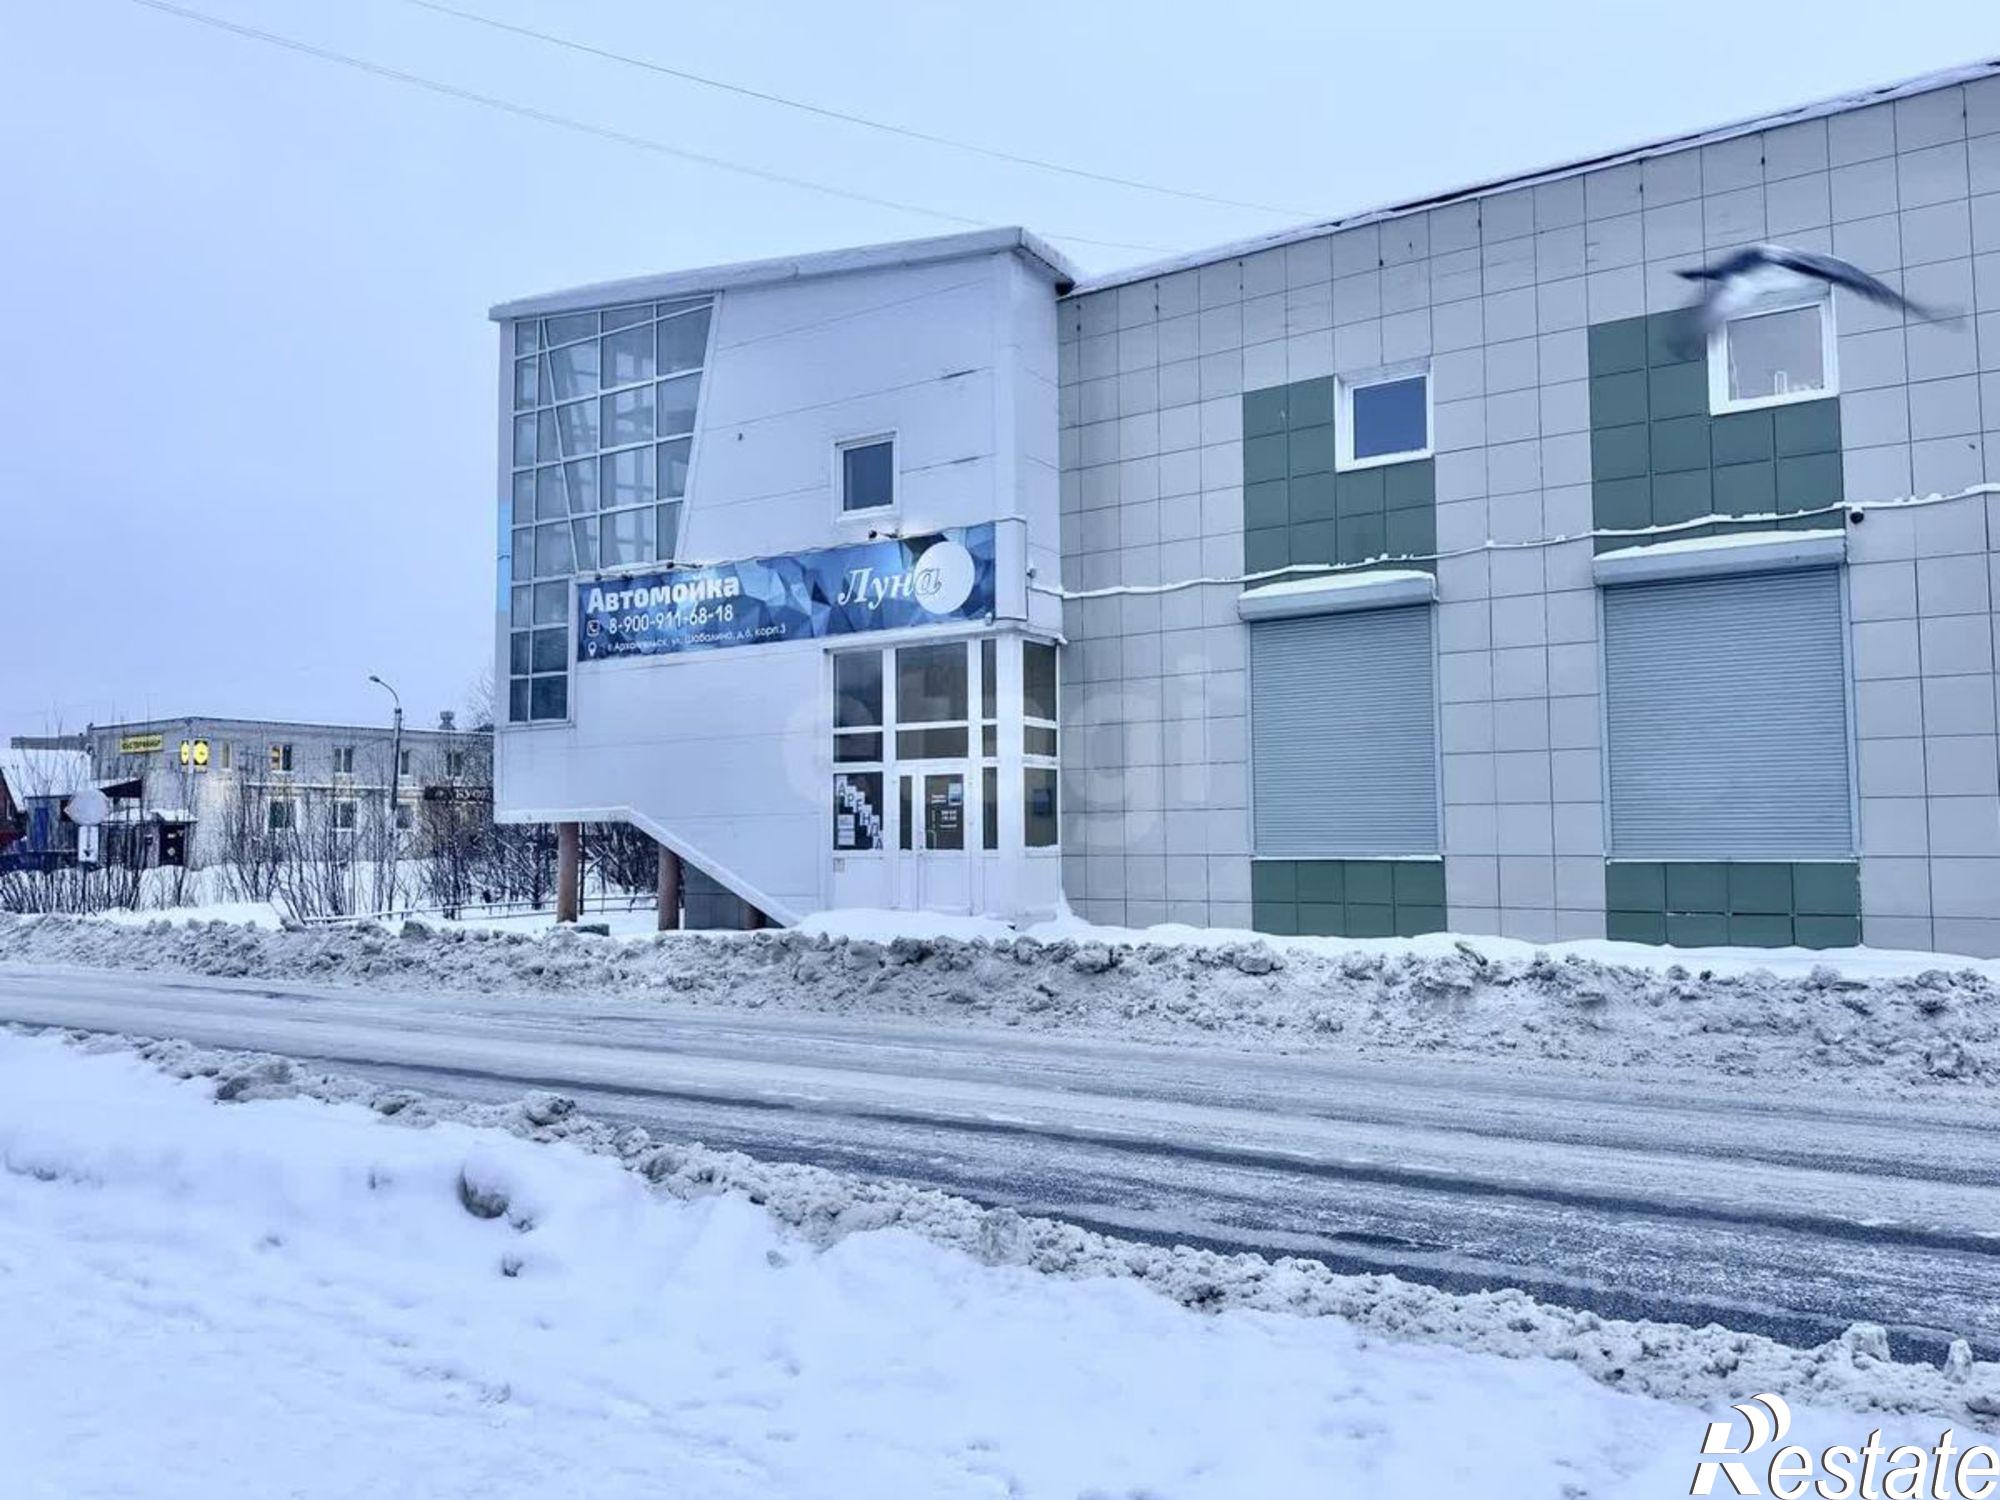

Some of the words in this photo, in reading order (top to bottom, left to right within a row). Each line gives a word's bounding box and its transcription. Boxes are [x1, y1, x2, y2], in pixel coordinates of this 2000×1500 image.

[587, 575, 740, 613] Автомойка
[838, 566, 942, 610] Луна
[608, 604, 734, 635] 8-900-911-68-18
